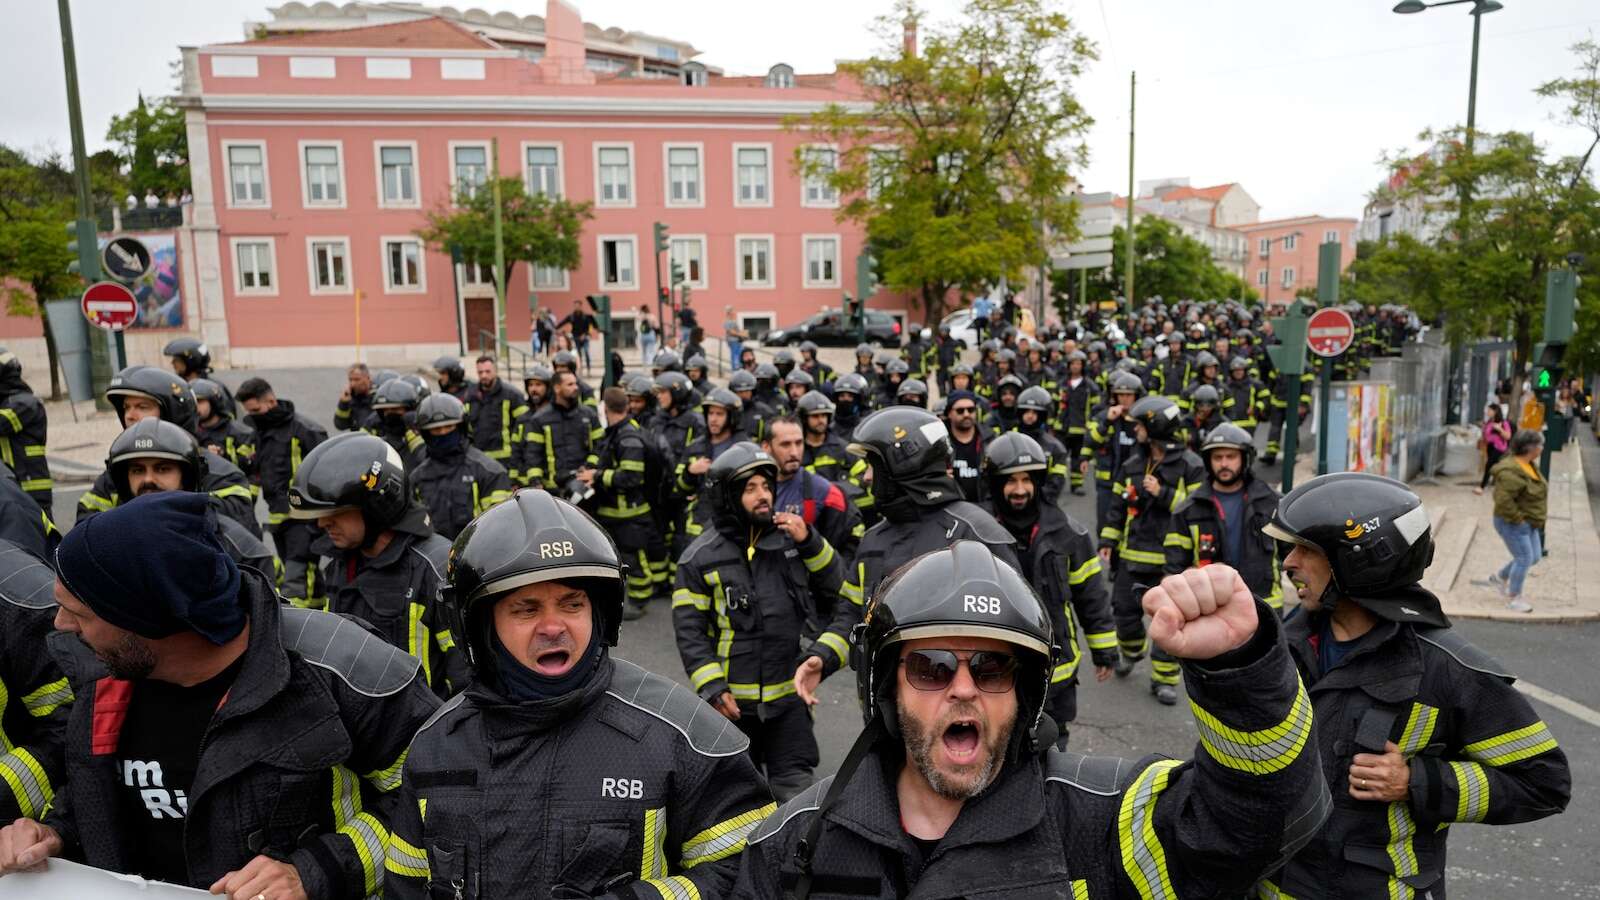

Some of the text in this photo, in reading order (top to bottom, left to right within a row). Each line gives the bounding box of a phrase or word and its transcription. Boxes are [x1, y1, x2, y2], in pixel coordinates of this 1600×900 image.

[134, 439, 153, 449] RSB
[540, 541, 574, 560] RSB
[964, 594, 1001, 615] RSB
[119, 759, 165, 787] m
[601, 777, 644, 799] RSB
